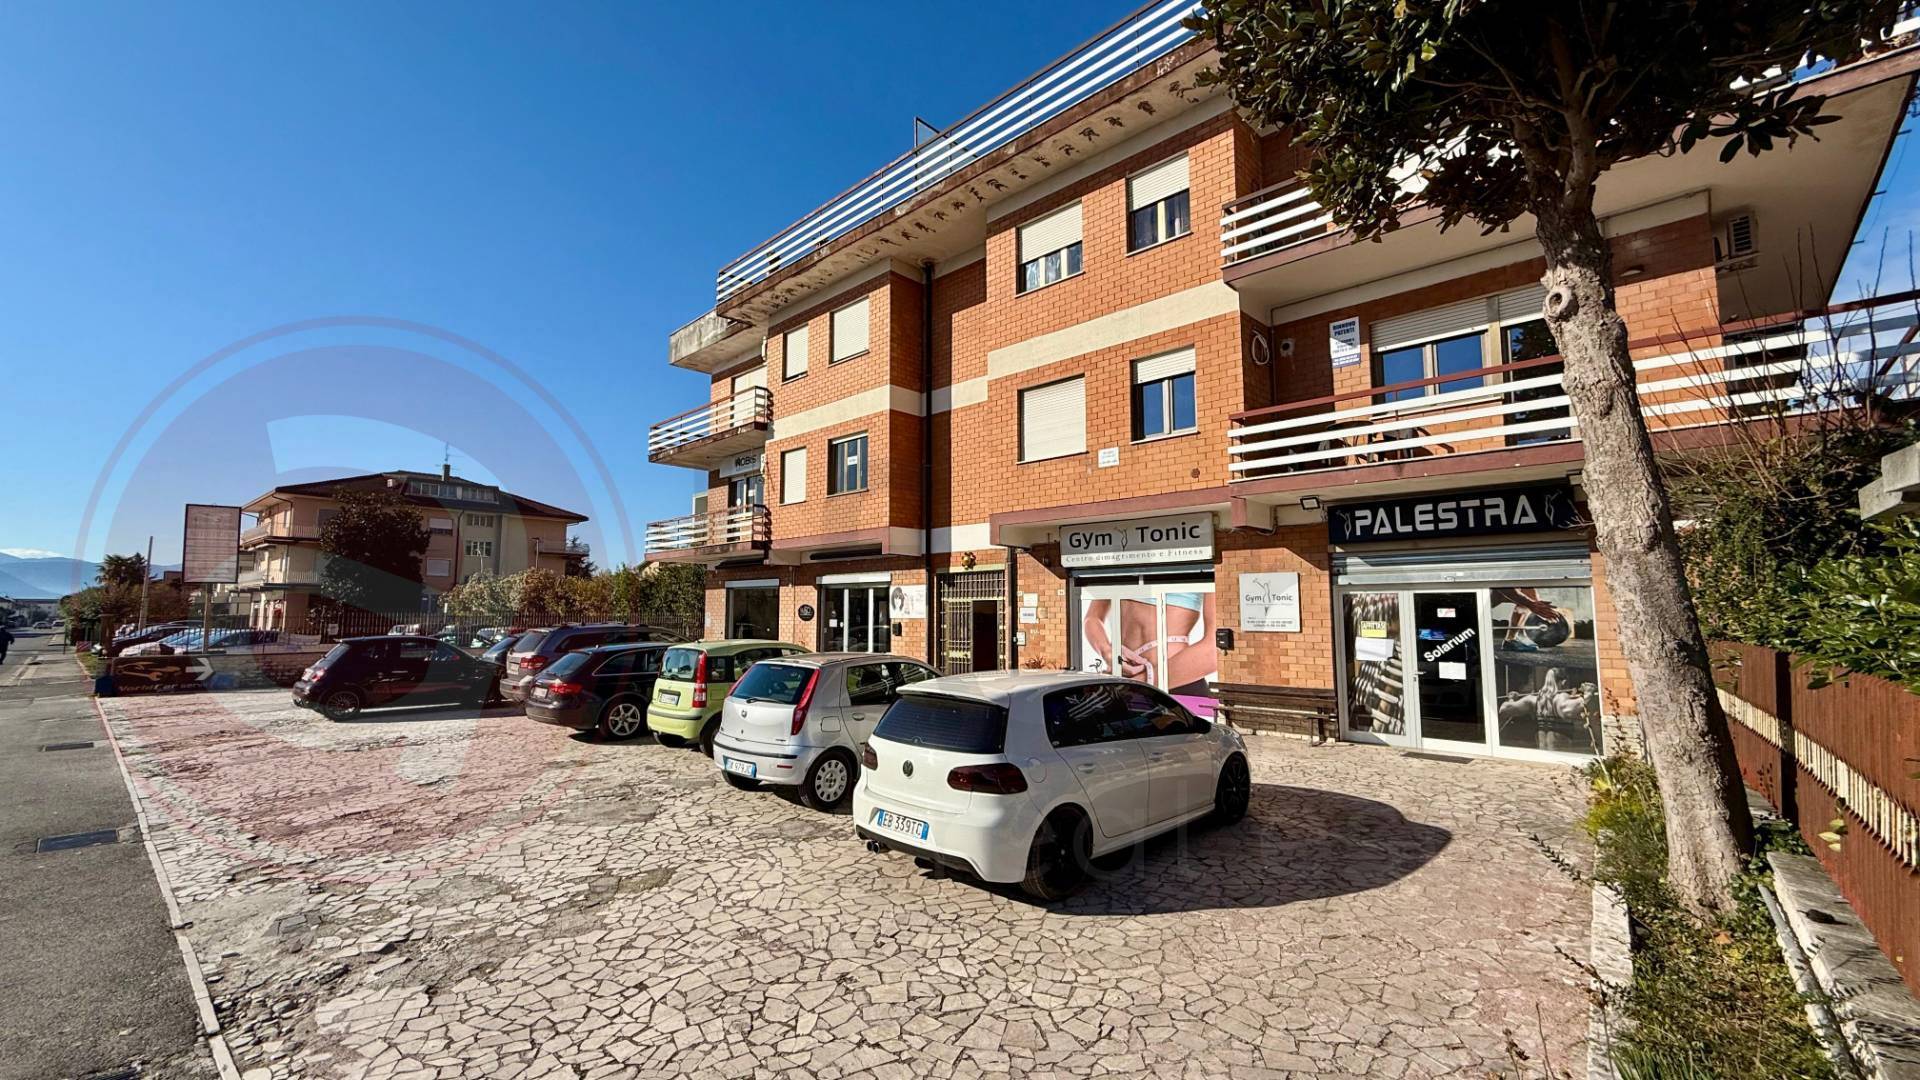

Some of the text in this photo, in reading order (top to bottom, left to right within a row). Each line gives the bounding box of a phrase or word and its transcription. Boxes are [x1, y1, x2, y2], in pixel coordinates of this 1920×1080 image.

[1354, 494, 1537, 536] PALESTRA
[1069, 521, 1201, 550] Gym Tonic
[1168, 548, 1203, 557] Fitness
[1245, 593, 1293, 603] Gym Tonic
[1424, 628, 1476, 662] Solarium
[883, 813, 922, 836] EB 339TC
